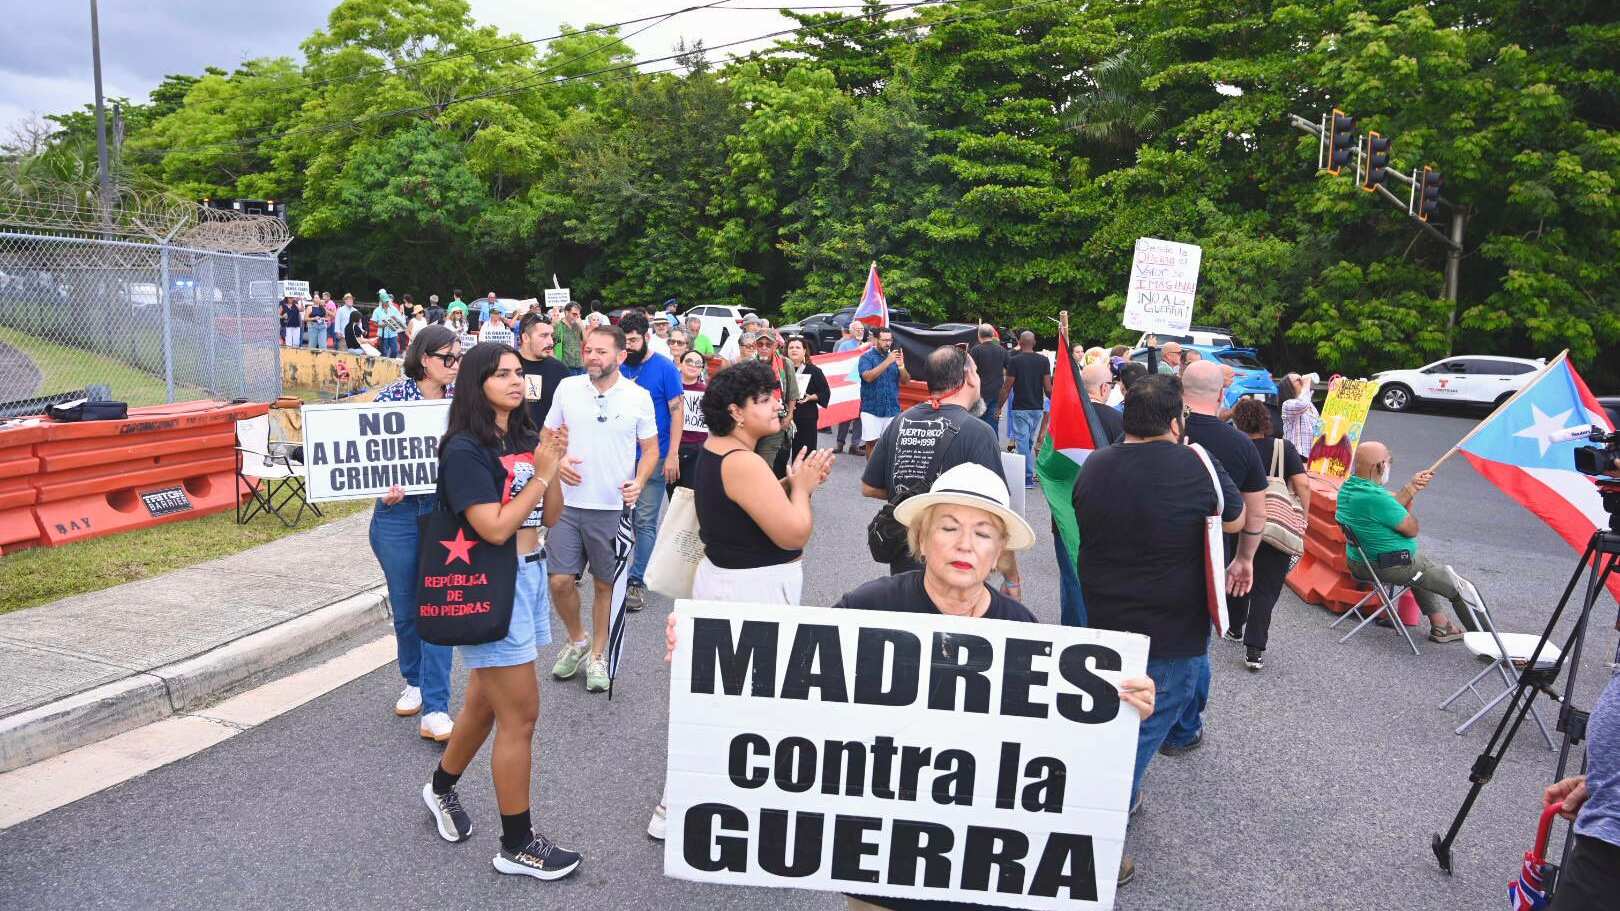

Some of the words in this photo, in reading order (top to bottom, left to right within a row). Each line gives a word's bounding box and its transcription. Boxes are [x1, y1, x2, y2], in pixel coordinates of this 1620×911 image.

[358, 411, 406, 436] NO
[899, 428, 926, 437] PUERTO
[926, 429, 941, 438] RICO
[312, 441, 328, 465] A
[332, 440, 361, 464] LA
[365, 435, 439, 462] GUERR
[149, 497, 190, 511] BARRIER
[447, 590, 464, 602] DE
[441, 601, 491, 616] PIEDRAS
[690, 616, 1123, 725] MADRES
[728, 732, 977, 807] contra
[995, 740, 1068, 815] la
[514, 851, 545, 869] HOKA
[683, 802, 1099, 903] GUERRA
